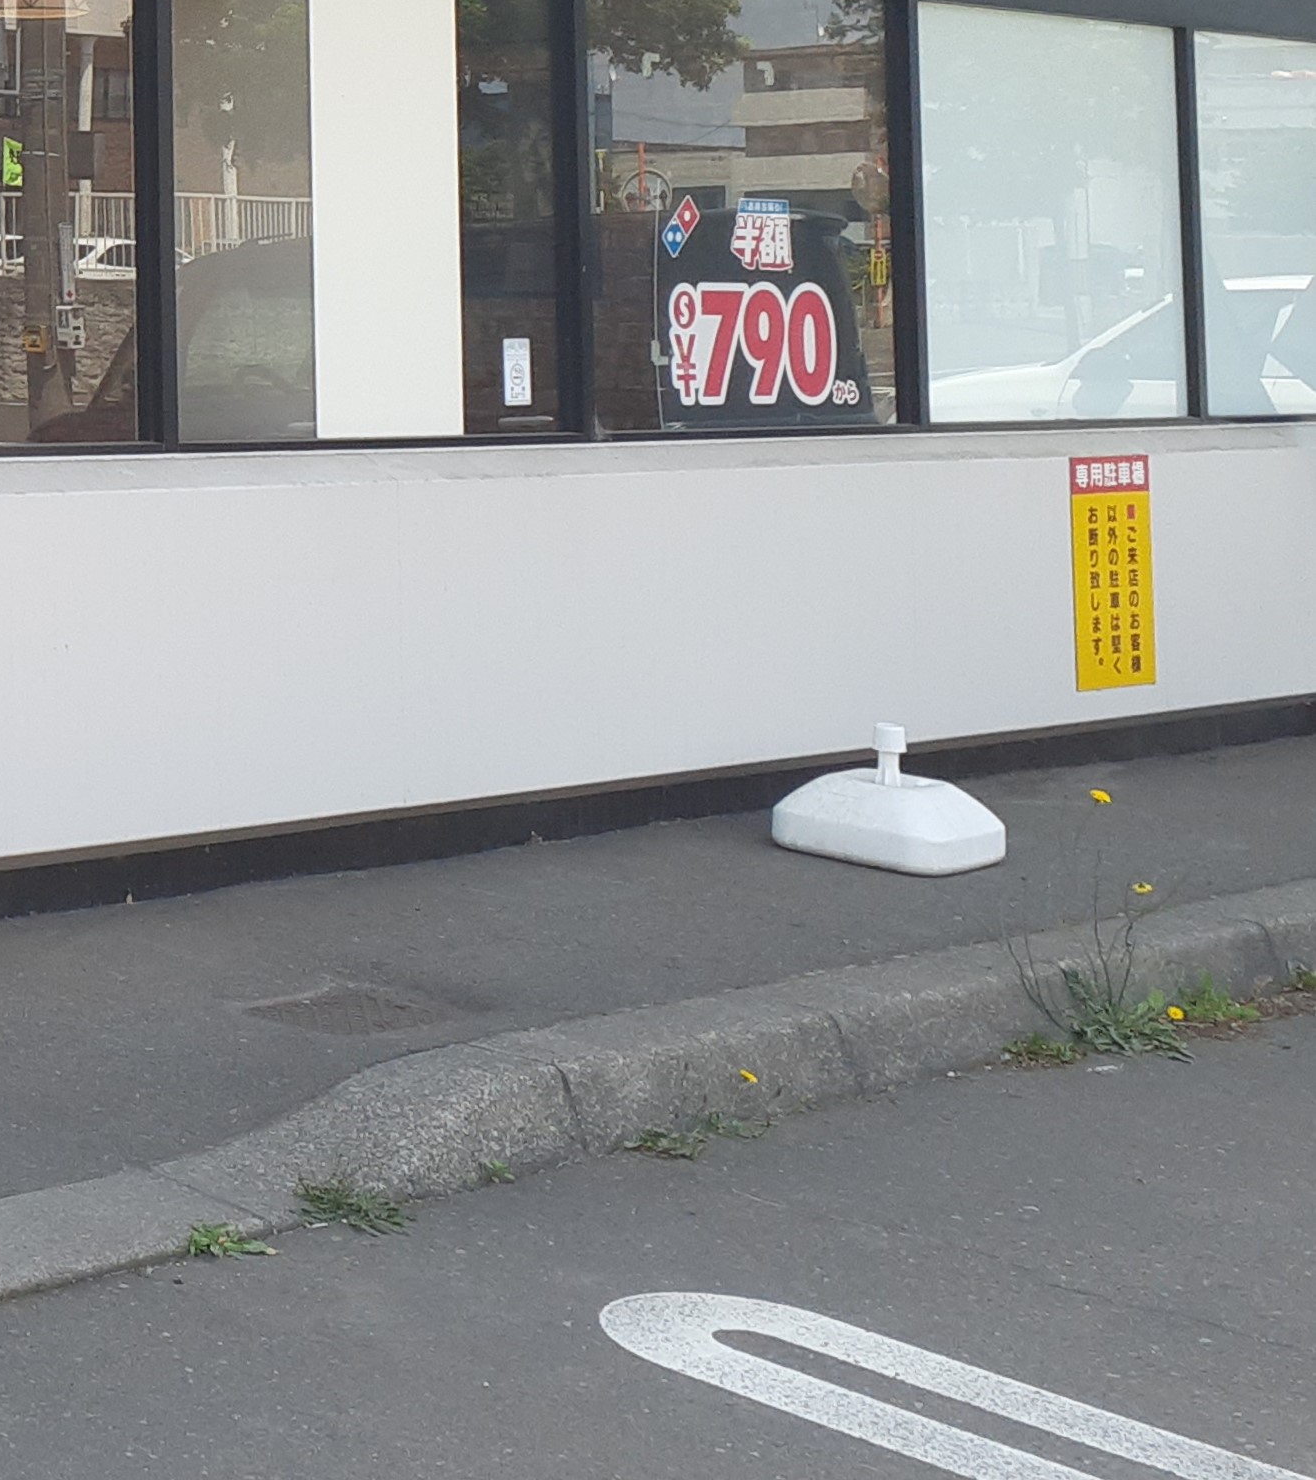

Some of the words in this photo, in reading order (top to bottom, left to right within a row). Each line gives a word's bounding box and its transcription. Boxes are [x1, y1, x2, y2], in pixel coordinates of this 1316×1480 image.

[733, 215, 791, 268] 半額
[1075, 460, 1145, 488] 専用駐車場
